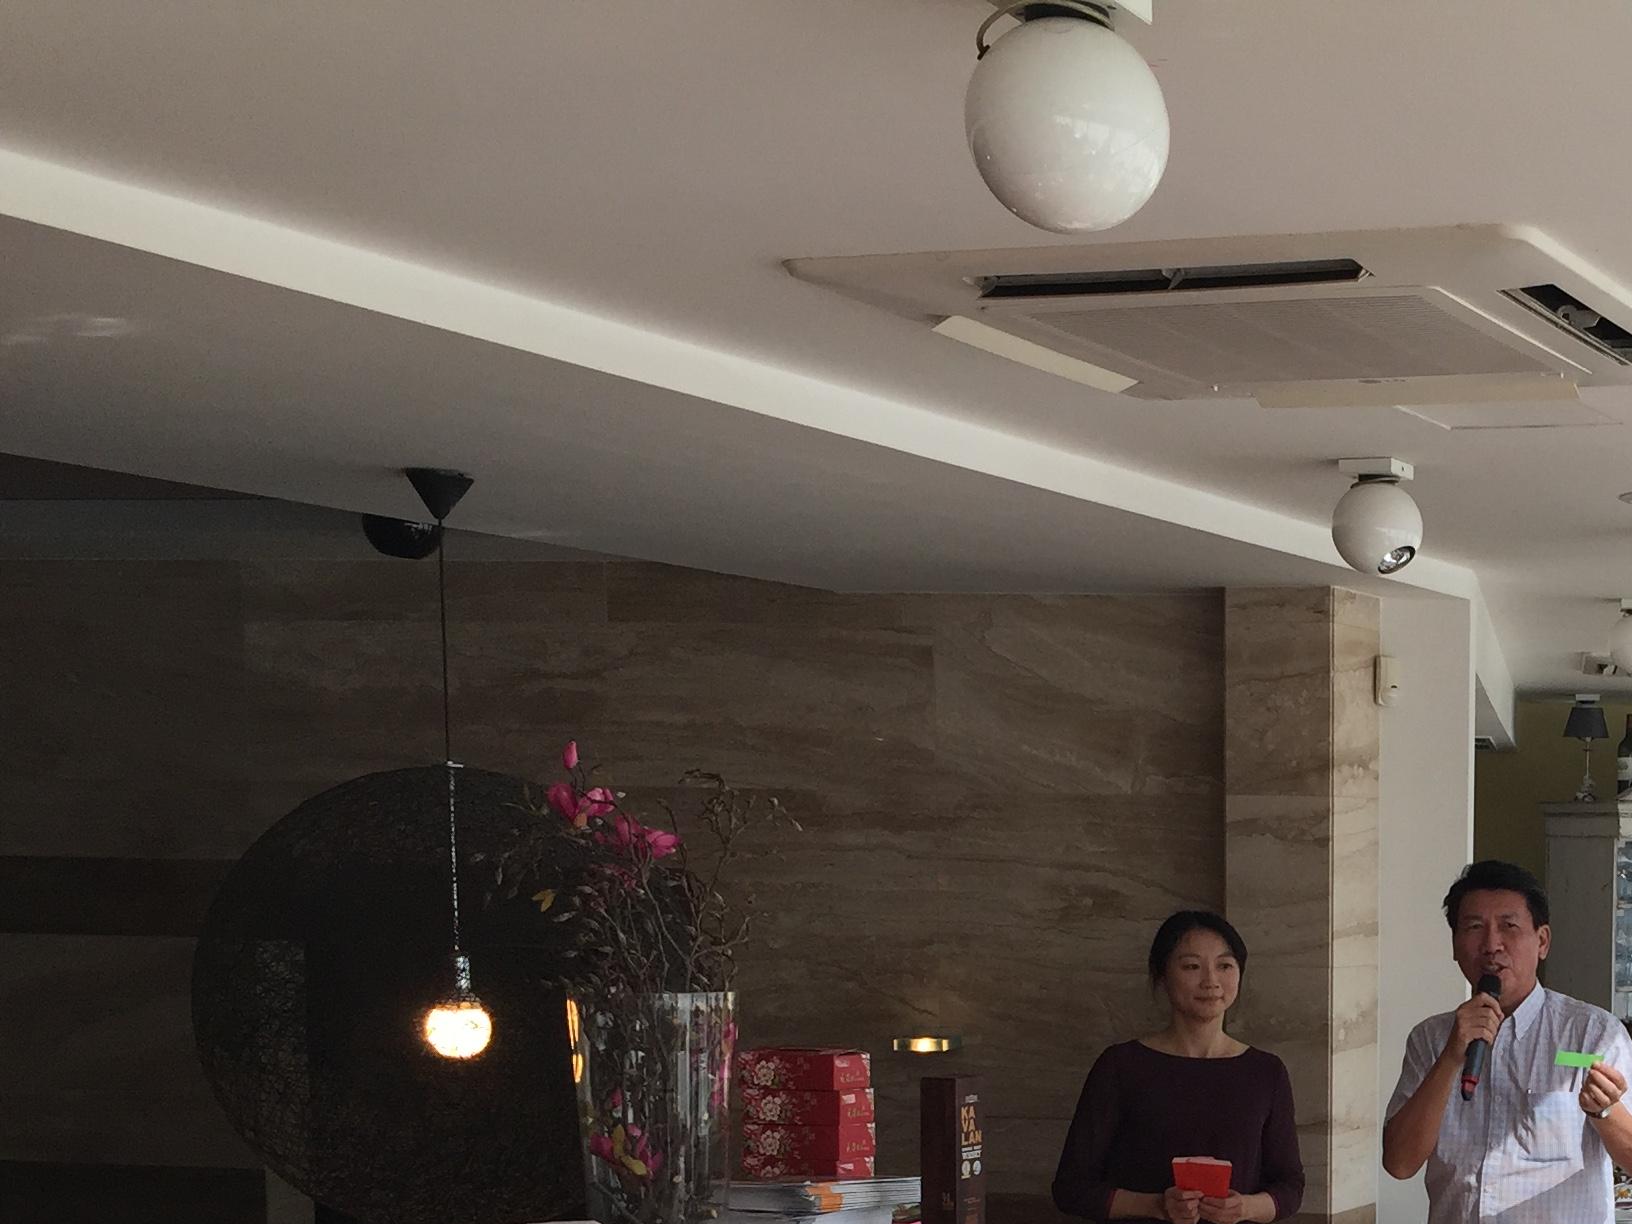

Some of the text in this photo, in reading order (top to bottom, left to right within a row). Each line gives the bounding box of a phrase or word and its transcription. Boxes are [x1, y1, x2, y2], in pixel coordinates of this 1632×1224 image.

[961, 1105, 976, 1119] KA
[961, 1118, 976, 1133] VA
[961, 1130, 982, 1145] LAN
